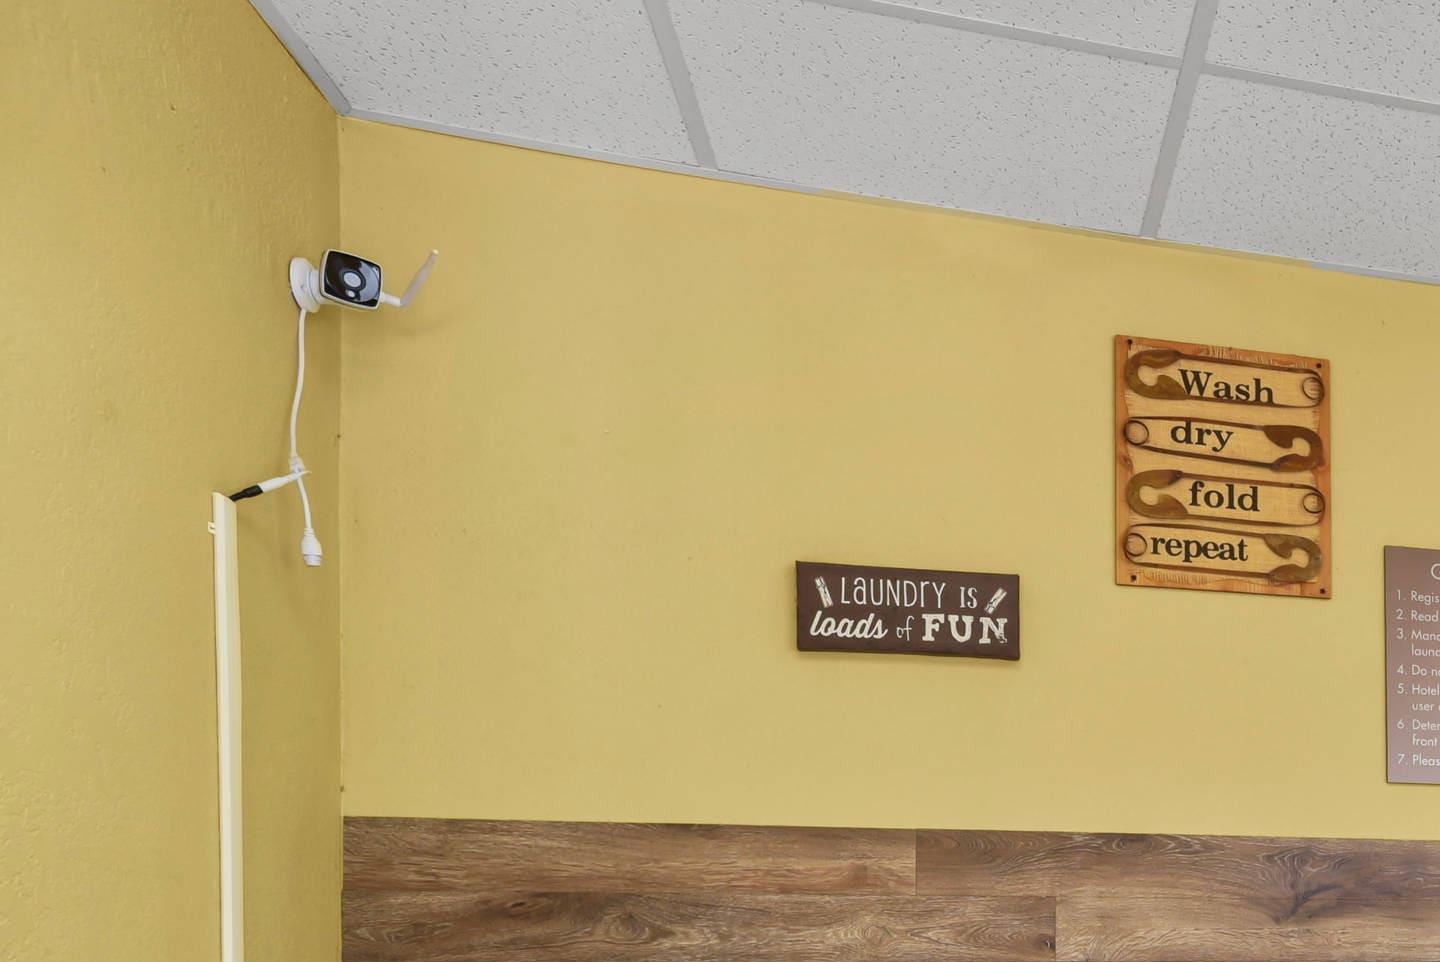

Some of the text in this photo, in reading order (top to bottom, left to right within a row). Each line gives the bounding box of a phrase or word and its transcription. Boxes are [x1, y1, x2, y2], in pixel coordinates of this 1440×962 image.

[1178, 368, 1274, 405] Wash
[1170, 421, 1233, 452] dry
[1188, 481, 1260, 512] fold
[1150, 536, 1248, 563] repeat
[1410, 610, 1439, 623] Read
[809, 610, 1008, 644] loads of FUN
[1411, 665, 1427, 676] Do
[1411, 684, 1440, 696] Hotel
[1412, 702, 1434, 713] user
[1412, 734, 1438, 747] front
